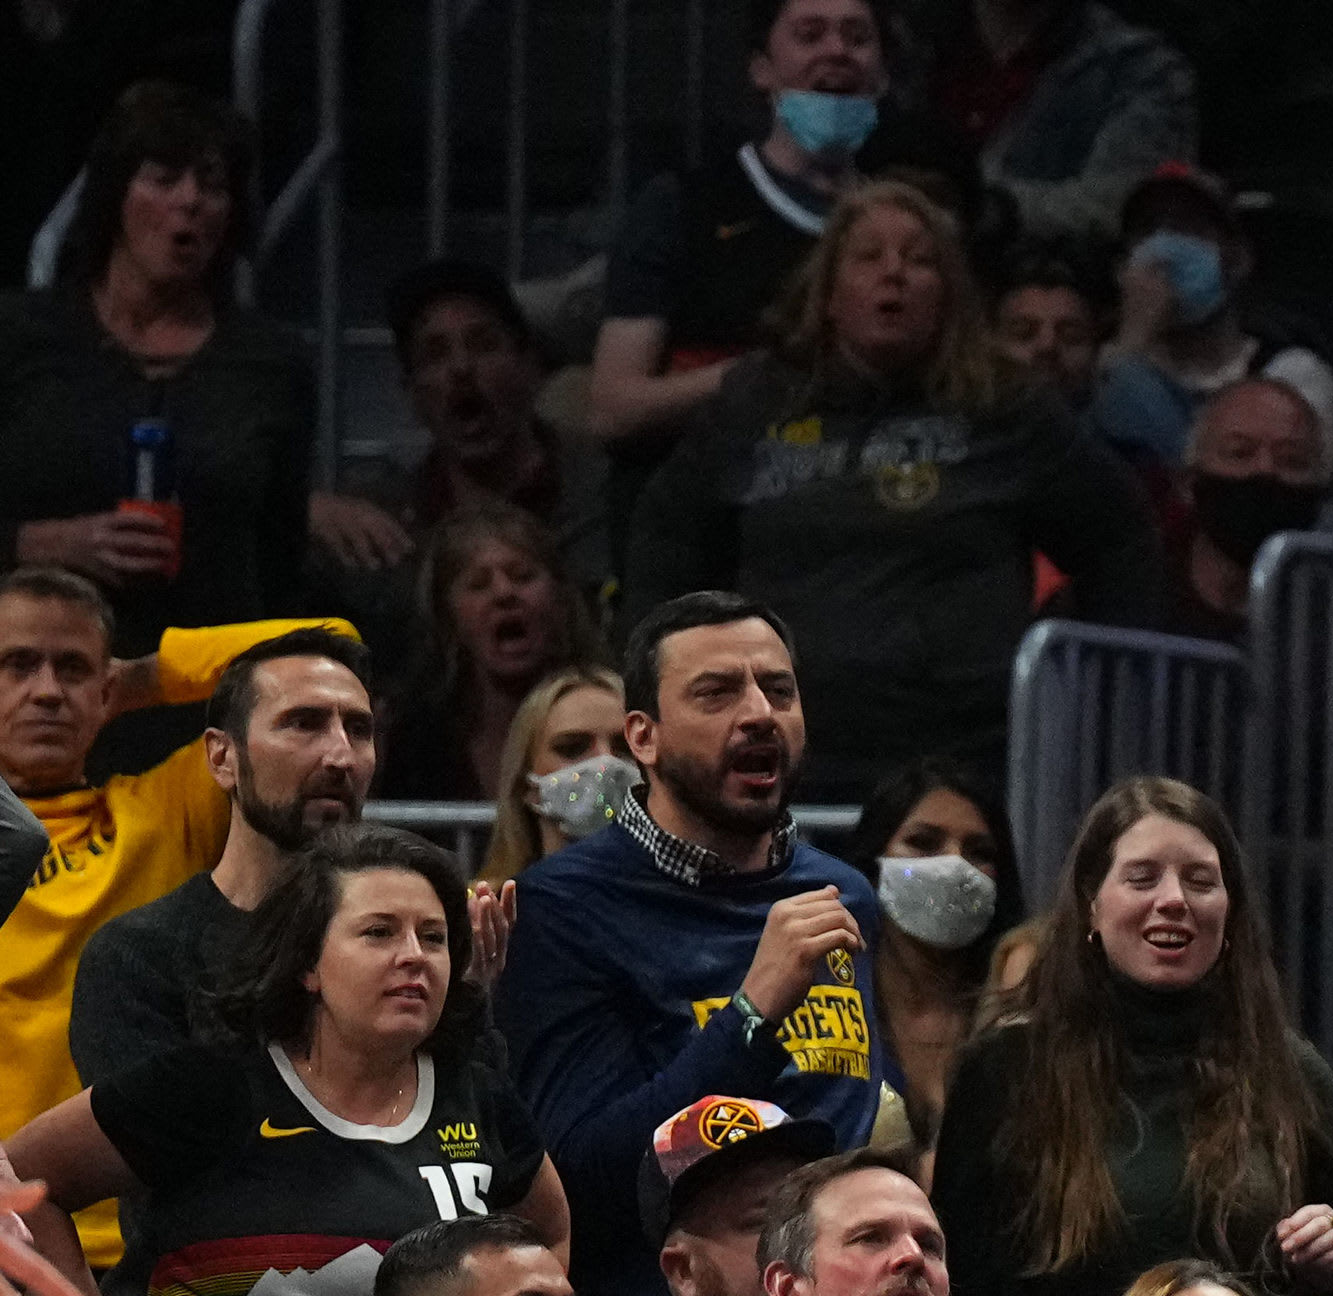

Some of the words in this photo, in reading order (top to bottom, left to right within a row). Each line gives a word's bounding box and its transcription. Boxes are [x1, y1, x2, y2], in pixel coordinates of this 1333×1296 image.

[778, 995, 865, 1044] GETS
[437, 1122, 477, 1142] WU
[440, 1141, 480, 1152] Western
[449, 1149, 476, 1159] Union
[418, 1162, 493, 1221] 15
